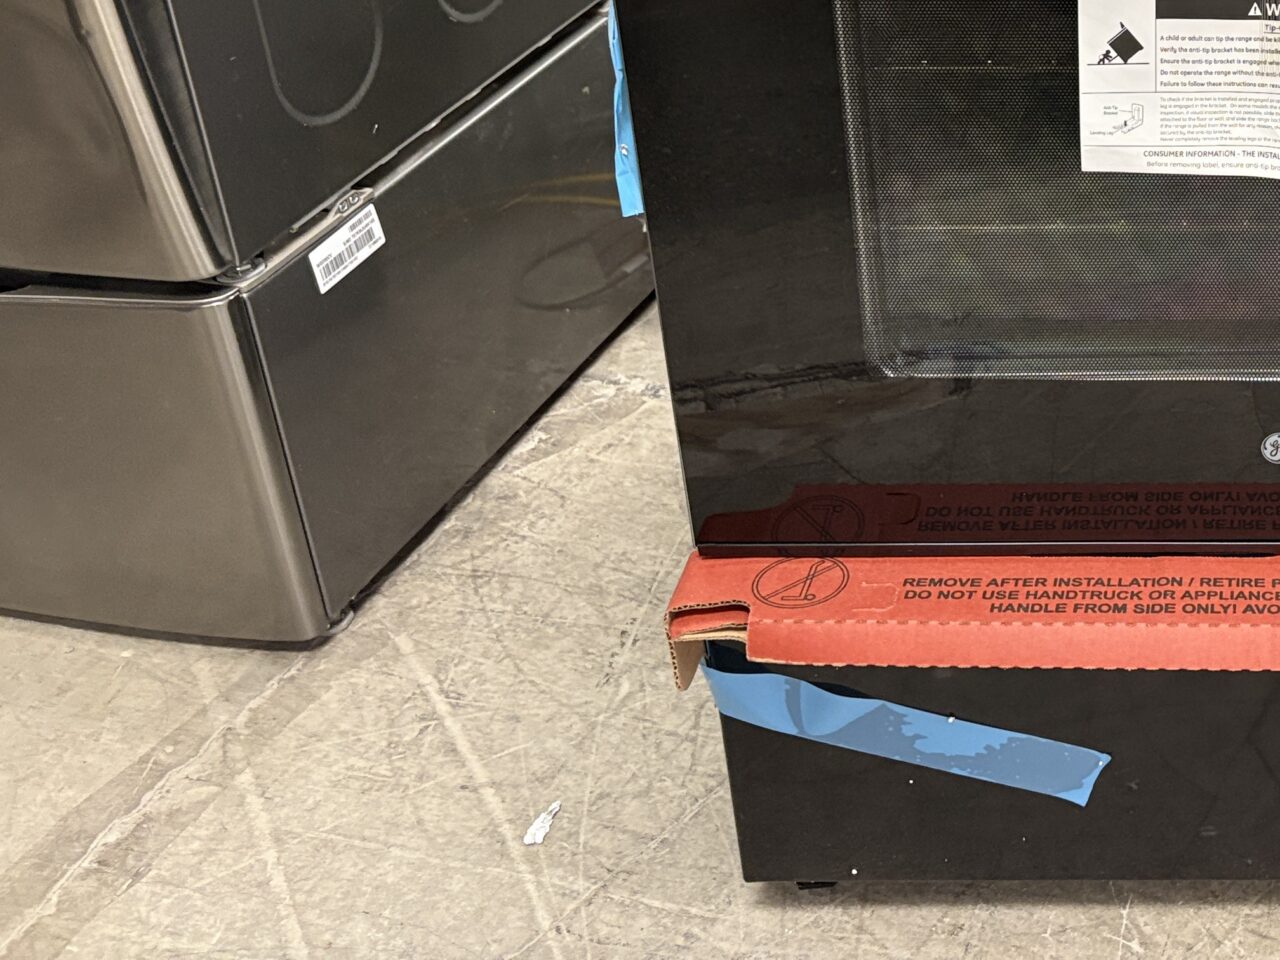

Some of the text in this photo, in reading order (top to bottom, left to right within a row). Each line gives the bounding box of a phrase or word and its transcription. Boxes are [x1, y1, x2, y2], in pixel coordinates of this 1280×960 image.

[1160, 46, 1177, 54] Verify
[1143, 150, 1184, 158] CONSUMER
[1170, 161, 1201, 169] removing
[1202, 161, 1219, 169] label,
[1245, 162, 1270, 170] anti-tip
[902, 577, 982, 588] REMOVE
[986, 577, 1047, 588] AFTER
[1052, 576, 1184, 588] INSTALLATION
[1199, 577, 1266, 588] RETIRE
[904, 590, 932, 599] DO
[937, 590, 977, 599] NOT
[981, 590, 1019, 599] USE
[1025, 590, 1143, 600] HANDTRUCK
[1148, 590, 1176, 599] OR
[989, 603, 1067, 613] HANDLE
[1072, 603, 1127, 613] FROM
[1132, 603, 1176, 614] SIDE
[1181, 603, 1237, 614] ONLY!
